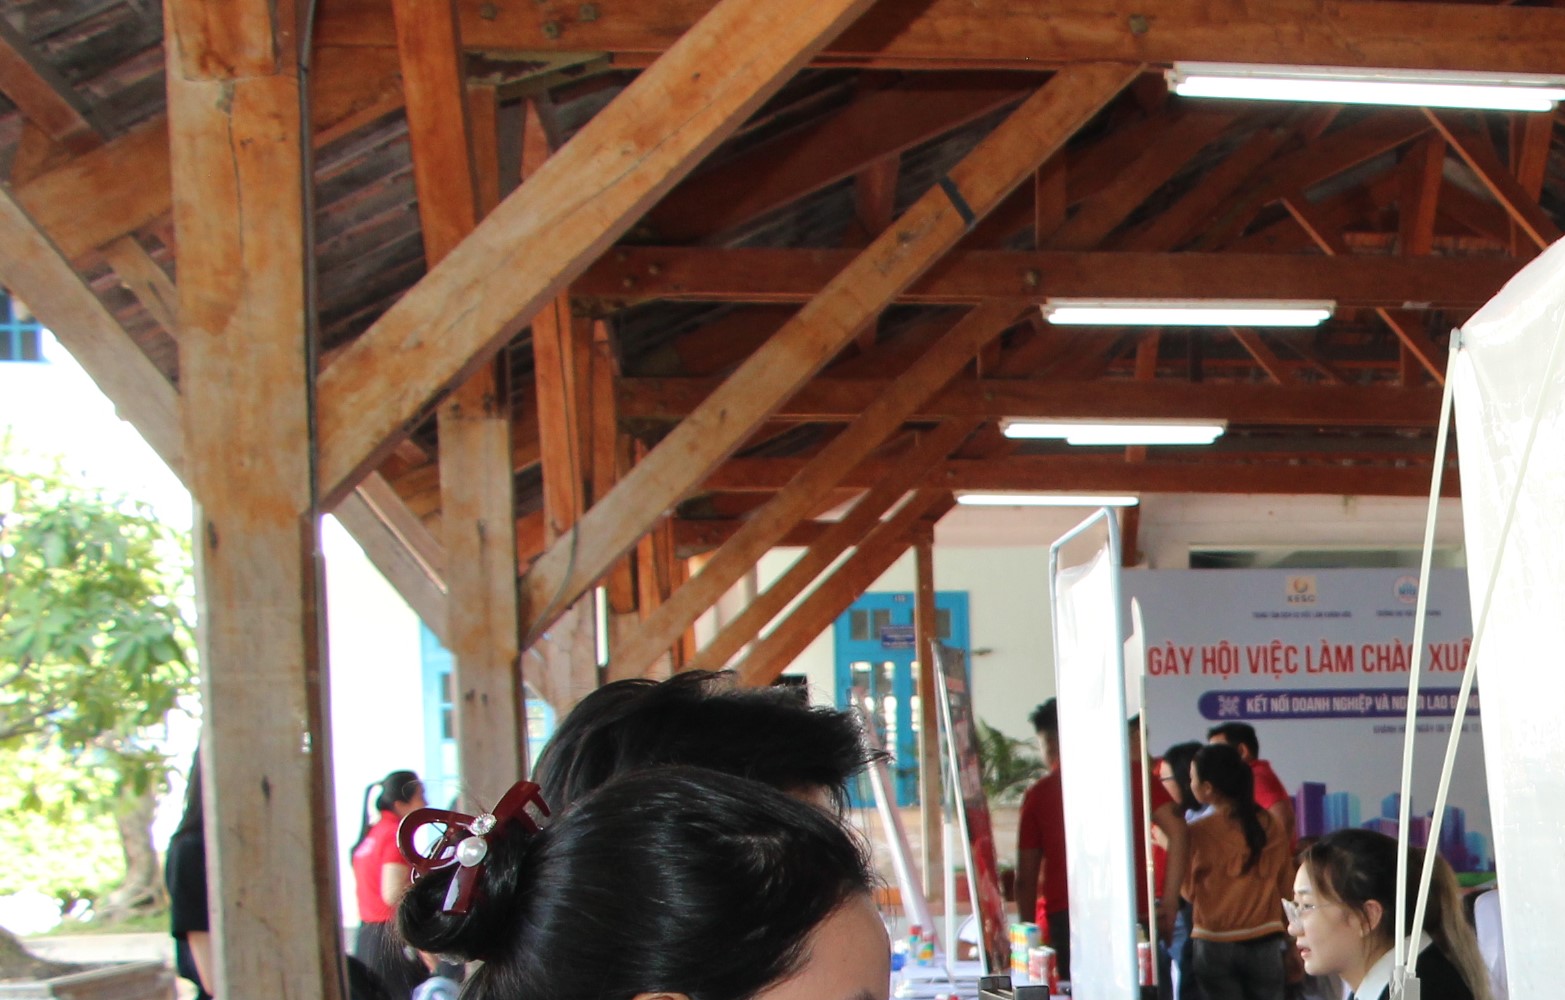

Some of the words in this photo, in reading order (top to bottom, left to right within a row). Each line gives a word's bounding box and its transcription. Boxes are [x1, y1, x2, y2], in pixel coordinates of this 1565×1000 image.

[1147, 640, 1194, 675] GÀY
[1201, 639, 1239, 680] HỘI
[1246, 639, 1298, 679] VIỆC
[1305, 639, 1354, 673] LÀM
[1428, 637, 1473, 672] XUÂ
[1246, 694, 1268, 712] KẾT
[1270, 694, 1289, 712] NỐI
[1292, 696, 1330, 712] DOANH
[1333, 694, 1373, 713] NGHIỆP
[1375, 693, 1390, 711] VÀ
[1427, 695, 1448, 709] LAO
